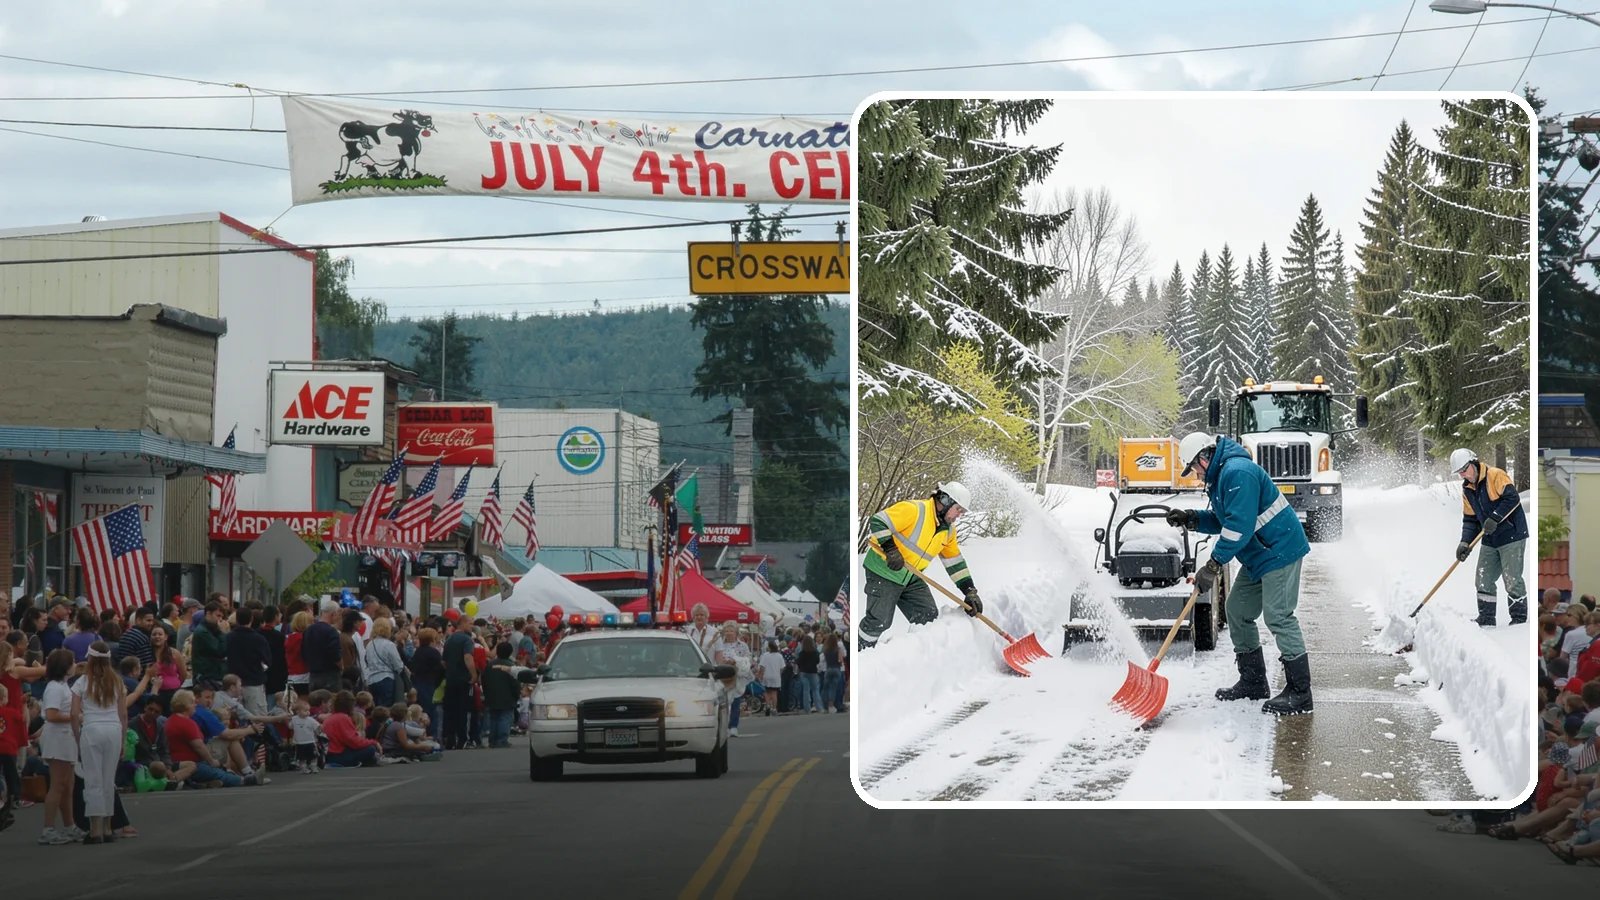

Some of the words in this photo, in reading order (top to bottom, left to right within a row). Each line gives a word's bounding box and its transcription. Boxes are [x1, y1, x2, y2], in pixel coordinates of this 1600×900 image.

[481, 141, 604, 192] JULY
[632, 150, 746, 197] 4th.
[697, 255, 850, 279] CROSSWA
[283, 380, 373, 420] ACE
[406, 409, 453, 422] CEDAR
[283, 421, 371, 436] Hardware
[354, 467, 386, 480] Simpl
[83, 484, 94, 495] St.
[95, 485, 124, 495] Vincent
[126, 486, 136, 495] de
[138, 486, 155, 495] Paul
[81, 503, 154, 522] THT
[212, 516, 331, 536] HARDARE
[688, 526, 742, 535] CRNATION
[699, 535, 730, 543] GLASS
